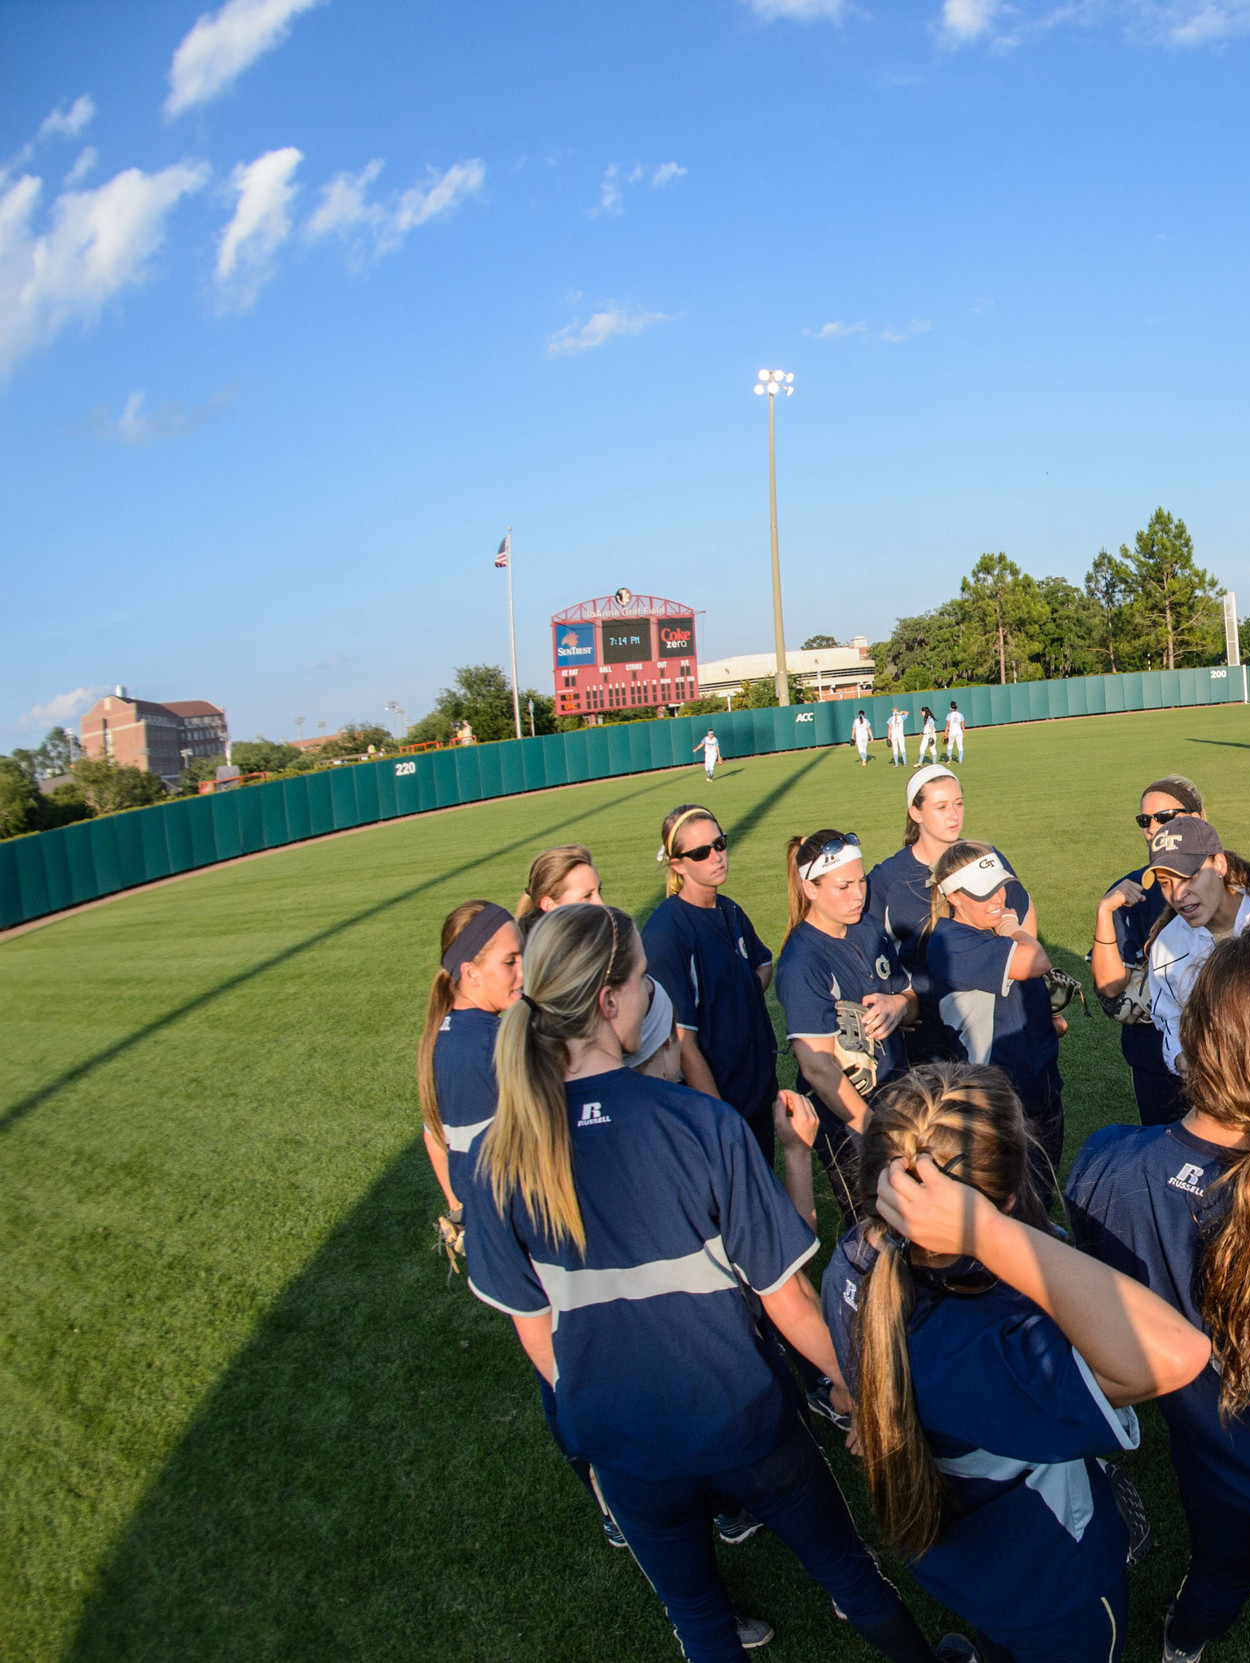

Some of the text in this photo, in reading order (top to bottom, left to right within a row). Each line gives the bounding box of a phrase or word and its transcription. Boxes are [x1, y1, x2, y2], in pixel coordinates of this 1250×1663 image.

[584, 609, 619, 619] JoAnne
[643, 606, 665, 615] Field
[661, 628, 691, 642] Coke
[609, 636, 640, 646] 7:14 PM
[666, 640, 687, 648] zero
[625, 663, 643, 671] STRIKE
[657, 661, 667, 669] OUT
[1210, 670, 1227, 678] 200
[795, 712, 814, 722] ACC
[395, 761, 416, 776] 220
[1151, 830, 1183, 852] GT
[978, 858, 995, 869] GT
[577, 1115, 611, 1127] RUSSELL
[1167, 1176, 1204, 1198] RUSSELL
